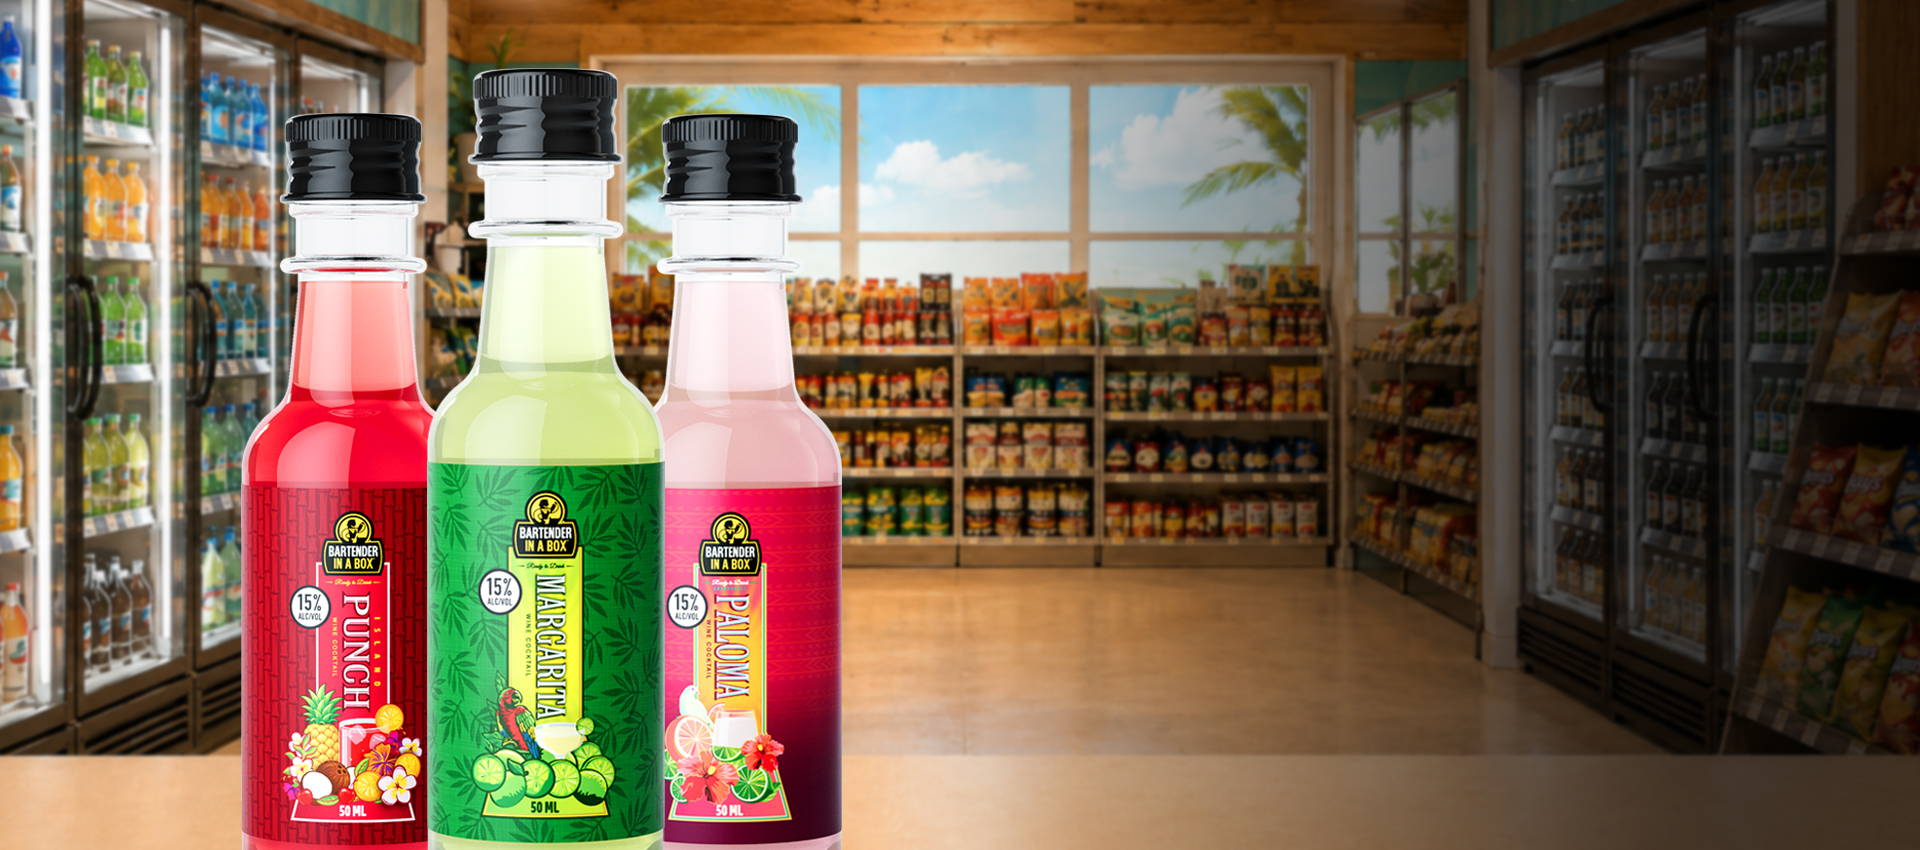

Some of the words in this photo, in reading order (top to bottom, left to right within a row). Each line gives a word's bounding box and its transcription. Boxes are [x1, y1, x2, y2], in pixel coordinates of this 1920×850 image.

[519, 526, 573, 539] BARTENDER
[328, 545, 379, 558] BARTENDER
[524, 540, 535, 552] IN
[536, 540, 545, 552] A
[546, 540, 567, 552] BOX
[705, 546, 756, 558] BARTENDER
[333, 558, 343, 570] IN
[345, 558, 352, 570] A
[354, 558, 374, 570] BOX
[710, 559, 720, 570] IN
[722, 559, 729, 570] A
[731, 559, 751, 570] BOX
[486, 577, 512, 596] 15%
[297, 594, 322, 611] 15%
[487, 598, 512, 606] ALC/VOL
[674, 593, 699, 611] 15%
[298, 612, 322, 620] ALC/VOL
[343, 592, 371, 711] PUNCH
[373, 616, 381, 687] ISLAND
[535, 574, 566, 720] MARGARITA
[714, 594, 750, 700] PALOMA
[339, 805, 351, 816] 50
[352, 805, 367, 816] ML
[531, 801, 542, 813] 50
[545, 801, 560, 813] ML
[715, 804, 727, 816] 50
[729, 804, 744, 816] ML
